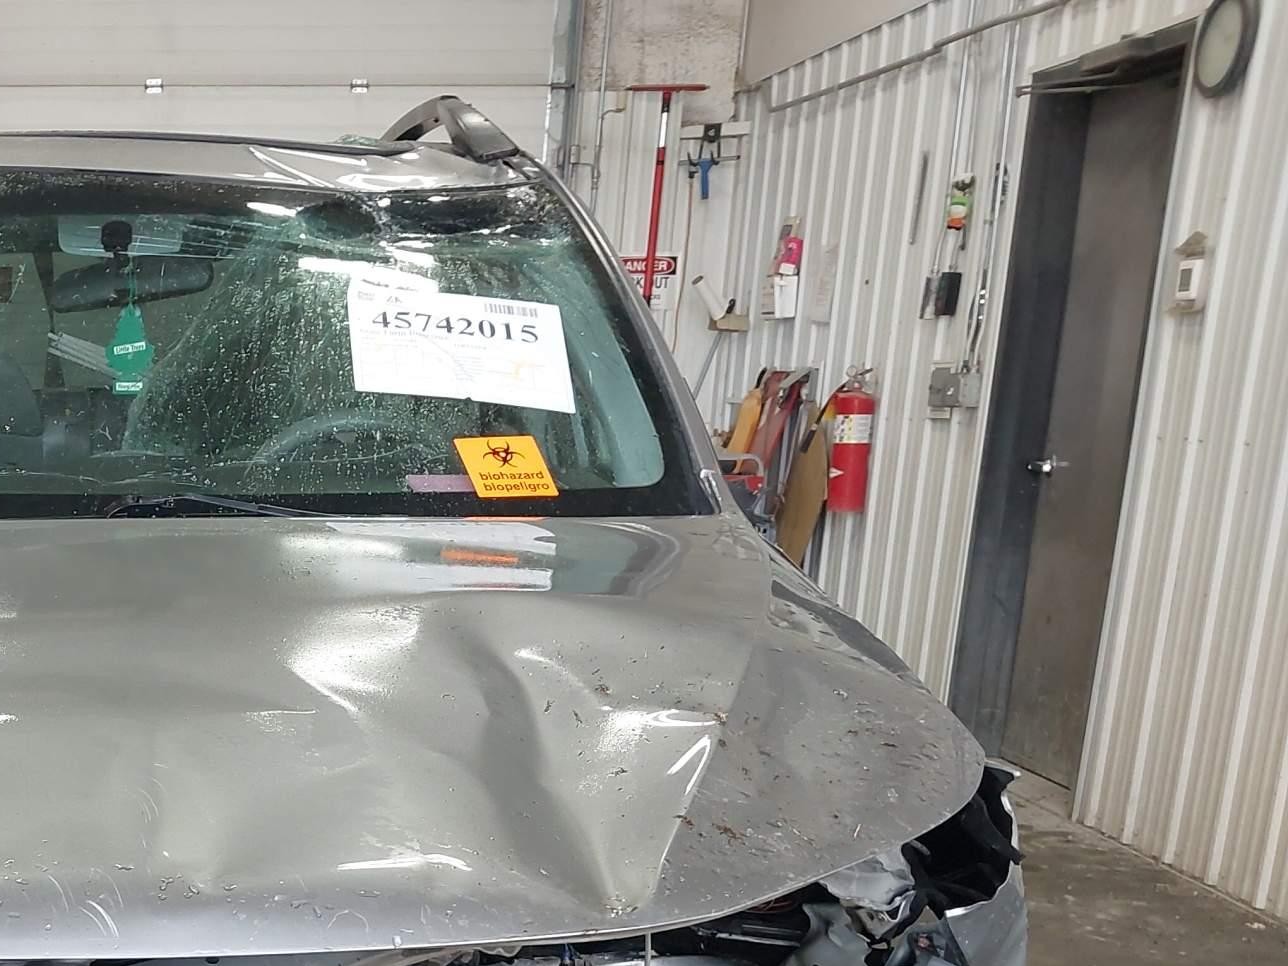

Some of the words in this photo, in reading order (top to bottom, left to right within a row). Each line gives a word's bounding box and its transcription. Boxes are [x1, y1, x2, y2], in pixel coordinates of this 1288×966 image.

[626, 260, 668, 271] ANER
[372, 311, 539, 343] 45742015
[479, 471, 545, 481] biohazard
[483, 481, 550, 492] biopeligro
